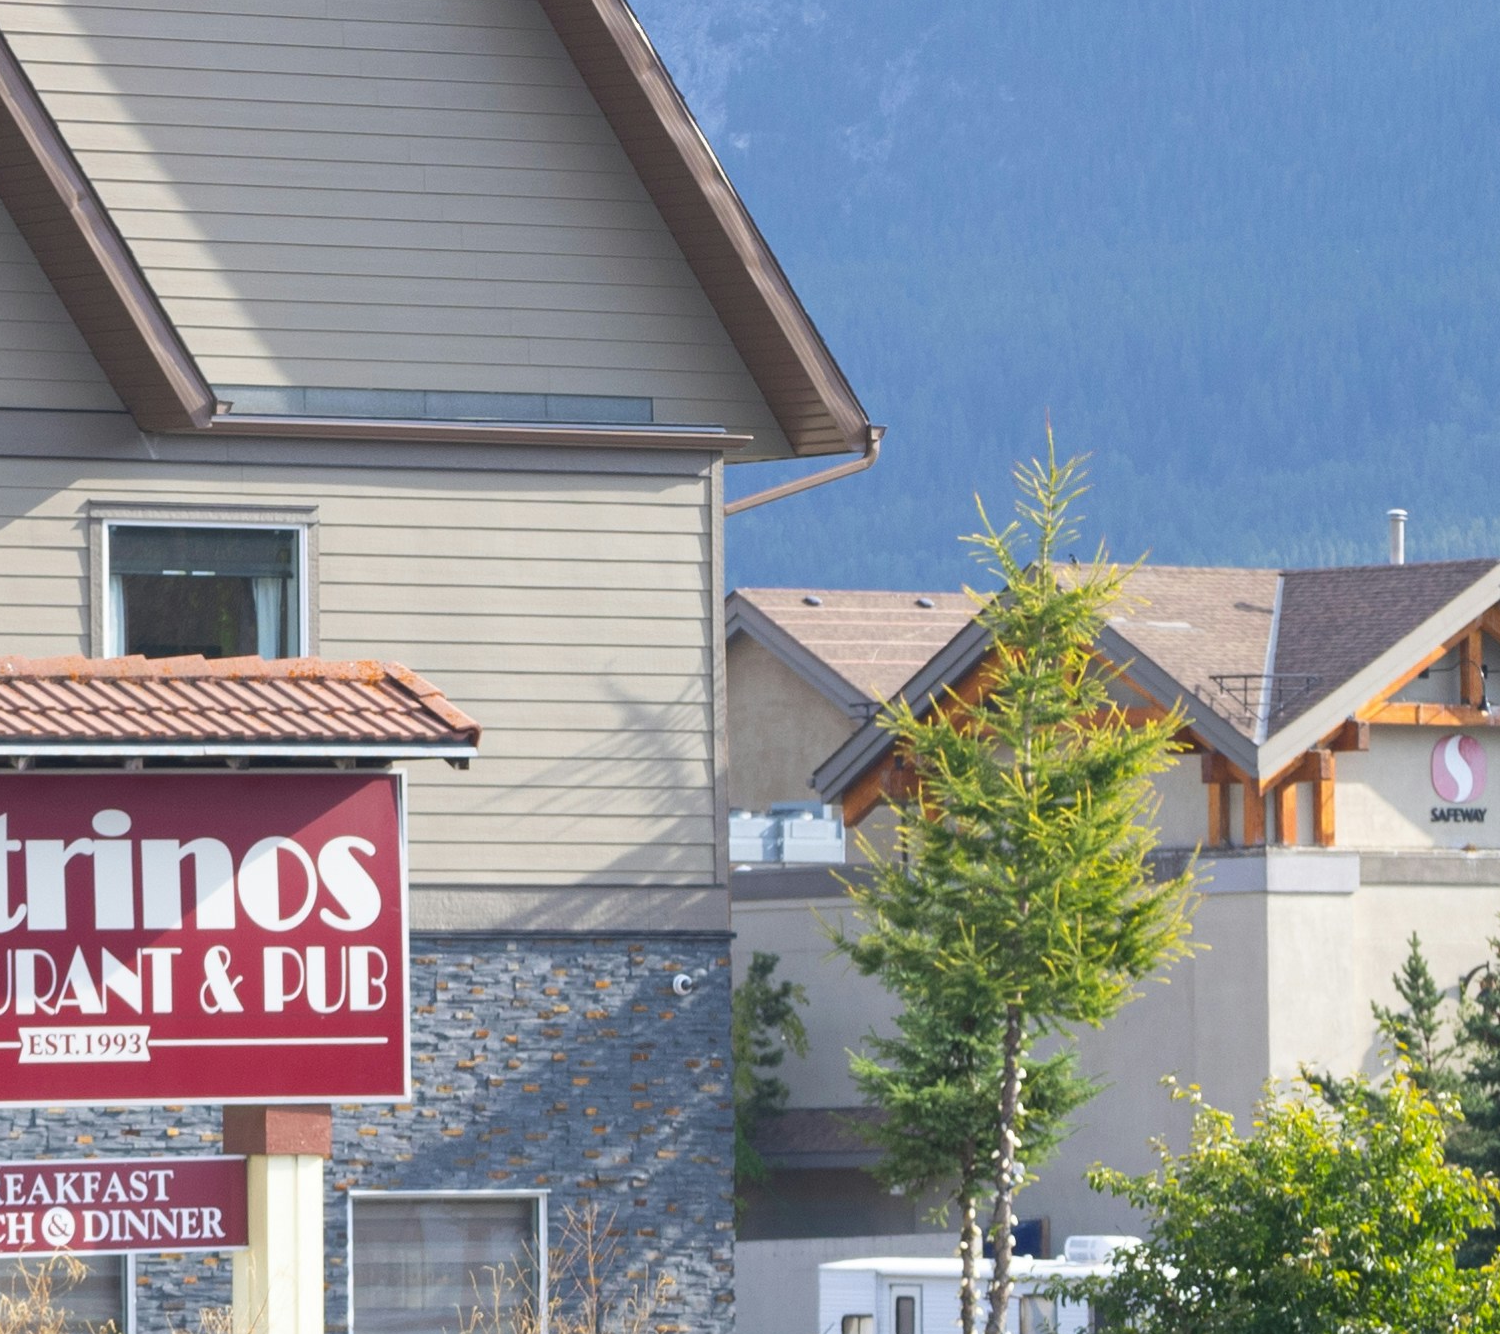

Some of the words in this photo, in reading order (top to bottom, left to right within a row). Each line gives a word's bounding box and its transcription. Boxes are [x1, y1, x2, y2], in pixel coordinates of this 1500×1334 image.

[1430, 808, 1487, 823] SAFEWAY
[200, 945, 244, 1015] &
[263, 945, 389, 1013] PUB
[82, 1207, 226, 1243] DINNER
